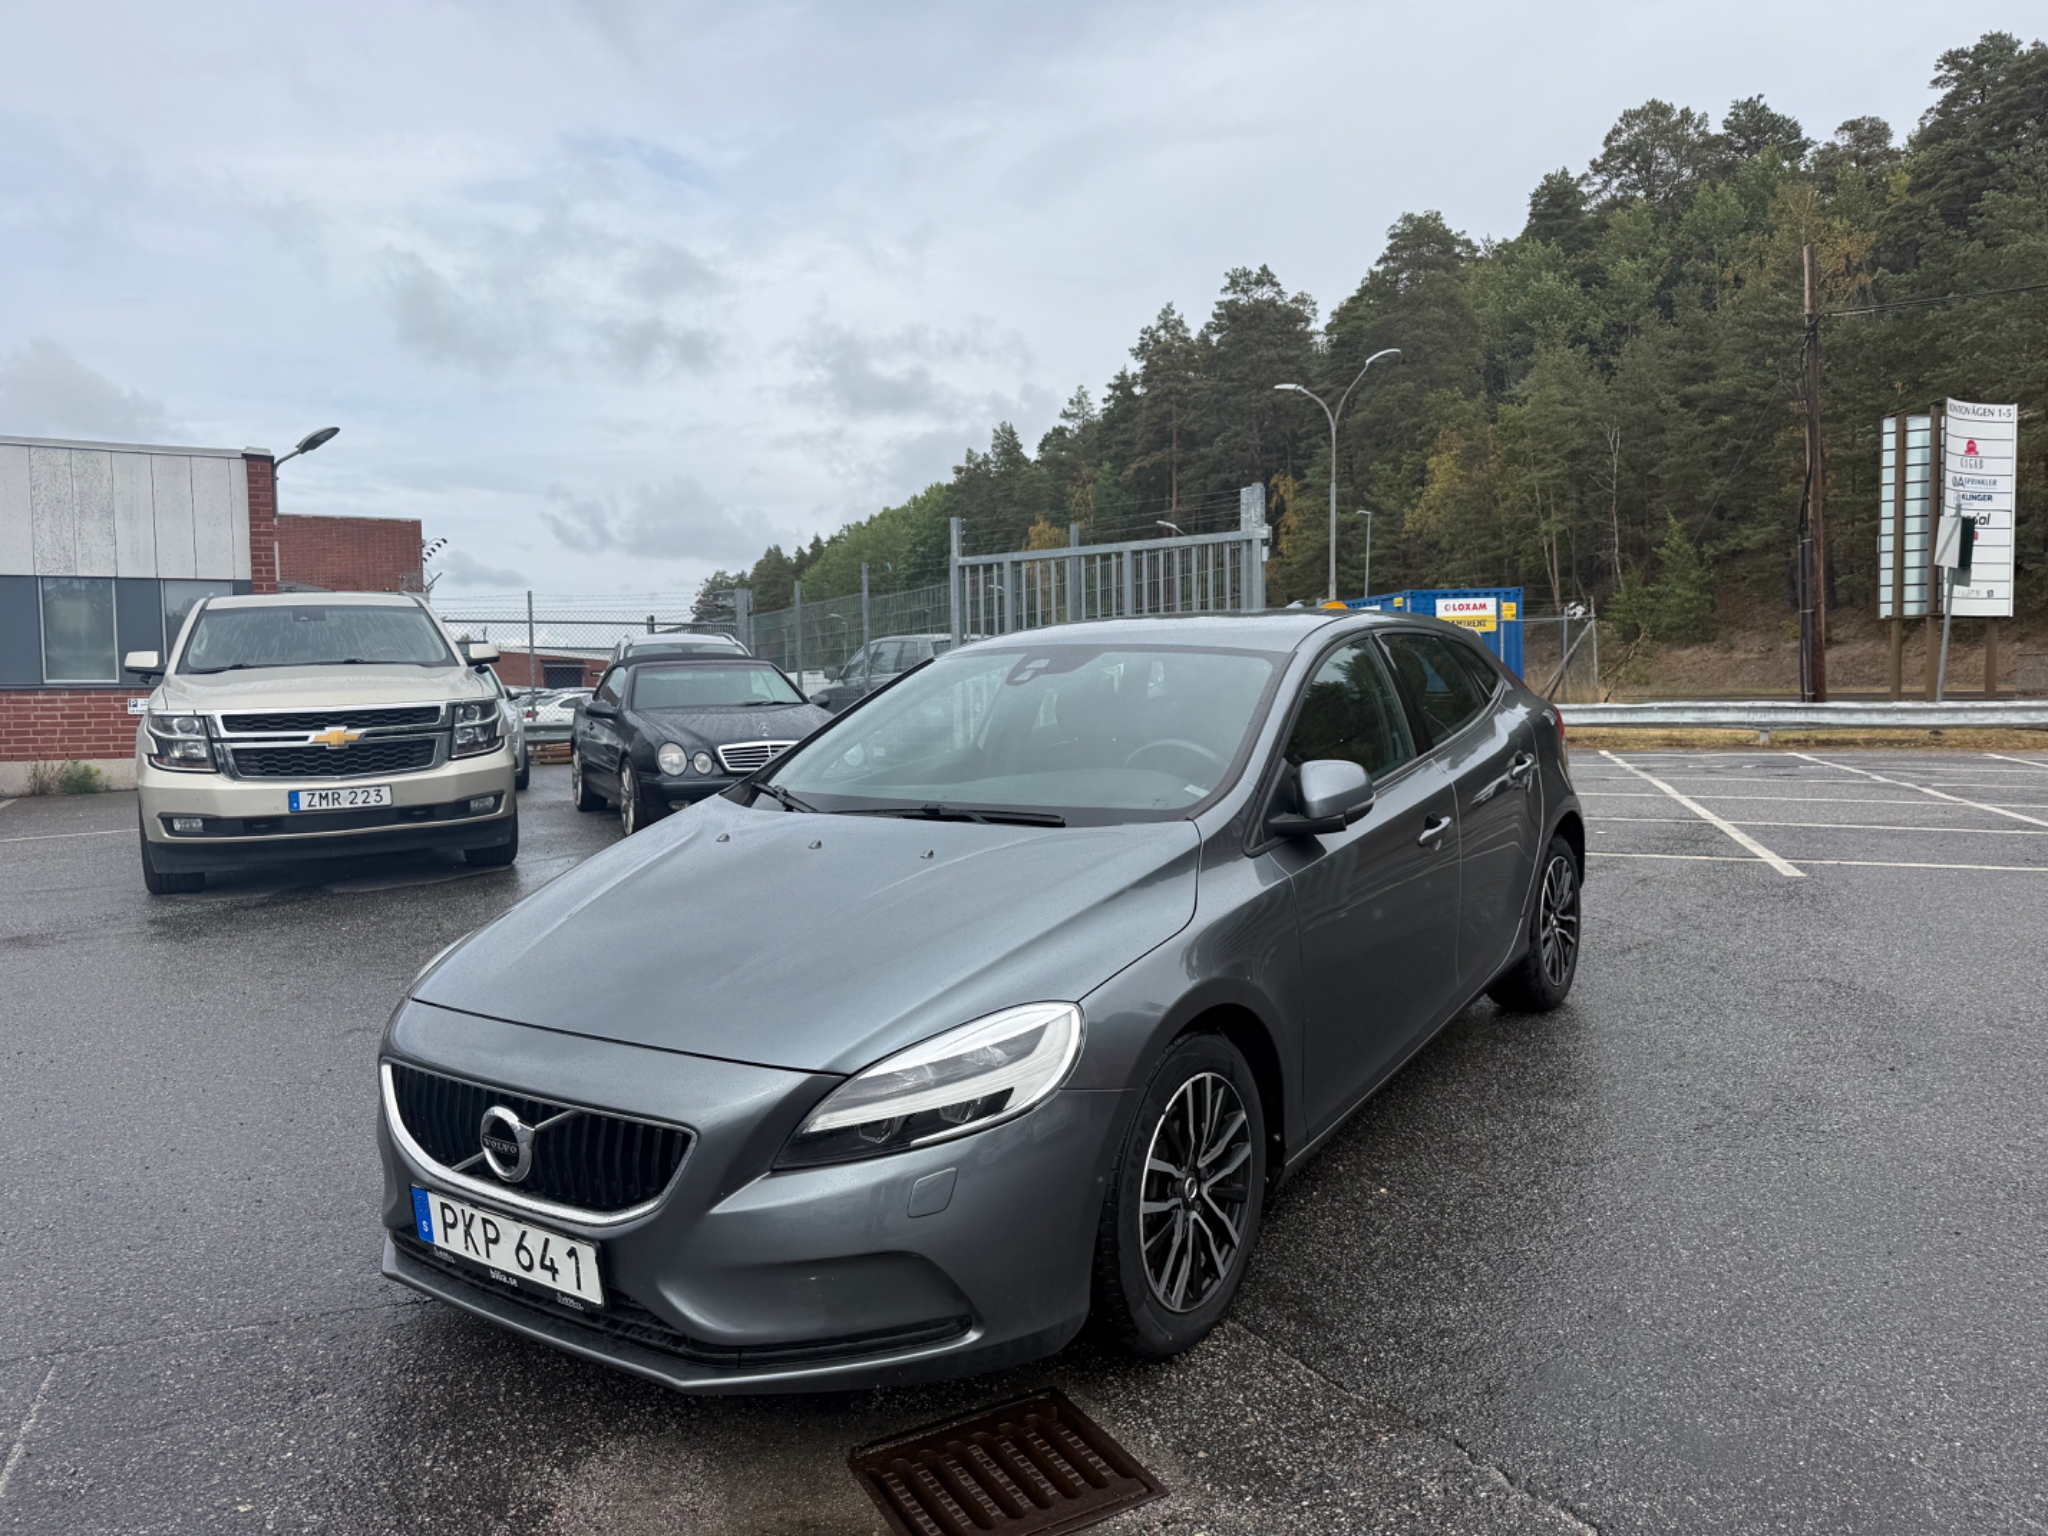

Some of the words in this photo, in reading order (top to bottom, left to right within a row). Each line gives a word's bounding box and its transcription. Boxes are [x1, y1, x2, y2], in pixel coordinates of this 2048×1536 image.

[1998, 408, 2012, 418] 1-5
[1962, 493, 1993, 502] KLINGER
[1452, 603, 1487, 612] LOXAM
[306, 791, 342, 808] ZMR
[348, 788, 384, 805] 223
[484, 1137, 517, 1154] VOLVO
[439, 1201, 501, 1259] PKP
[514, 1230, 583, 1292] 641
